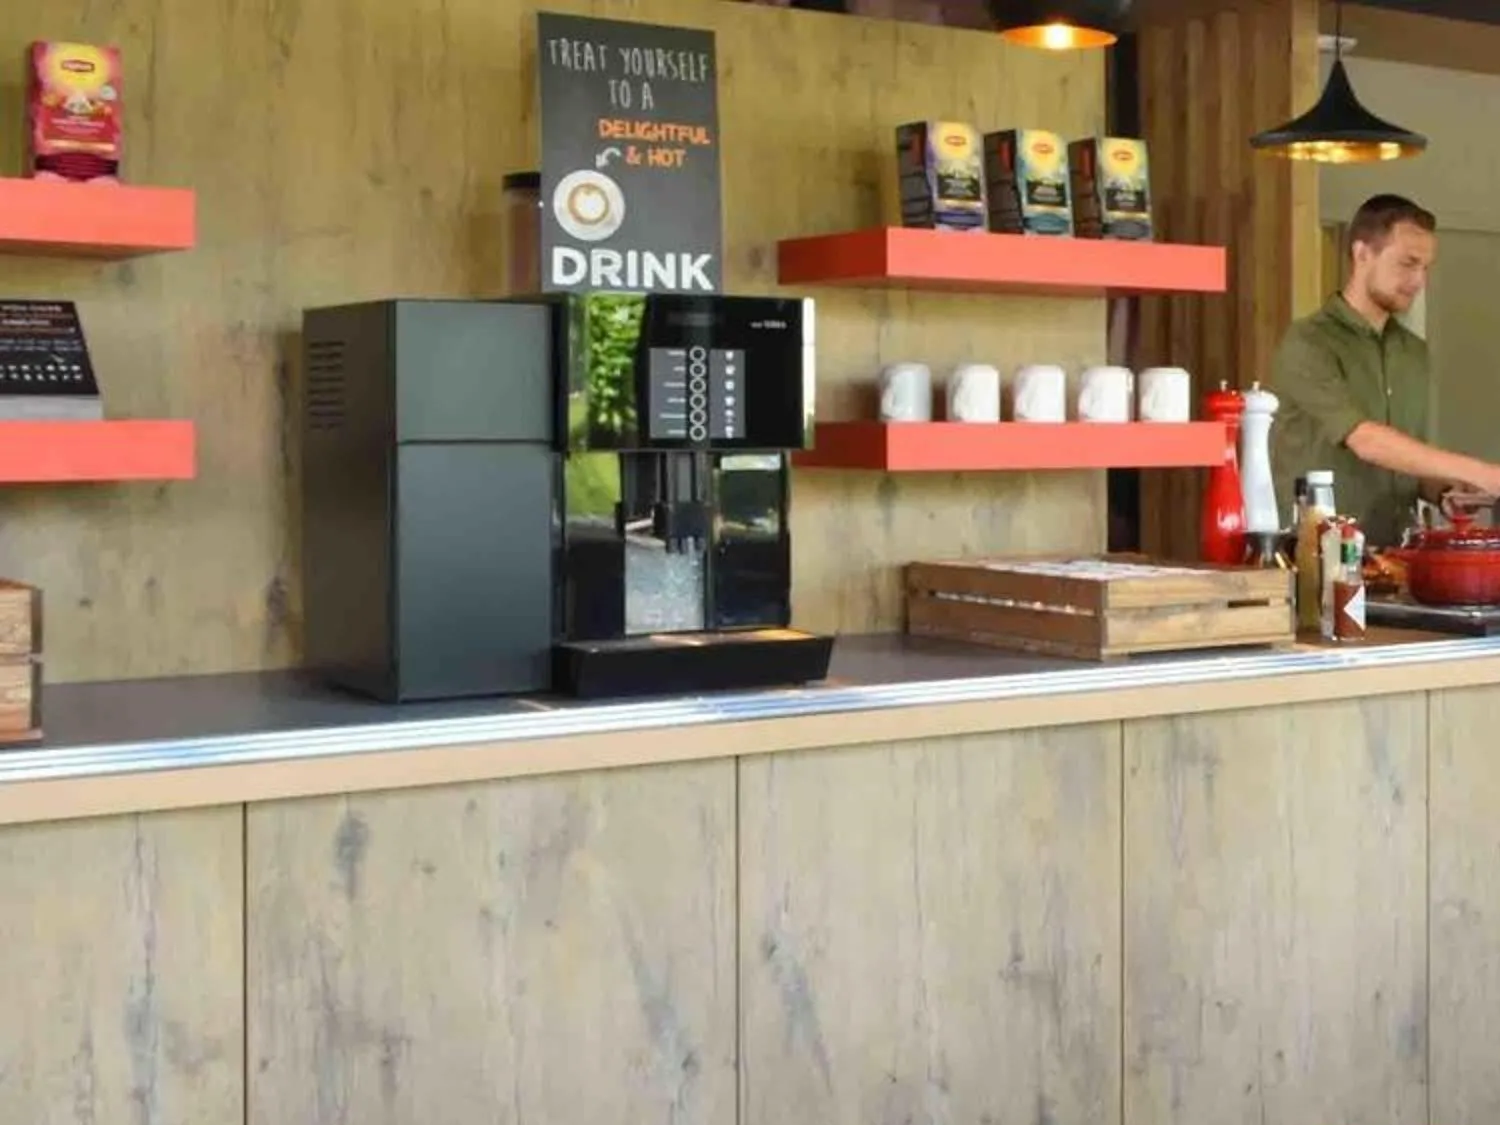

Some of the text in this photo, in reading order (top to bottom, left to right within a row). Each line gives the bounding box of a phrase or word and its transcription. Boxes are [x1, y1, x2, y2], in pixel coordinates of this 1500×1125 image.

[549, 38, 709, 82] TREAT YOURSELF
[608, 79, 654, 110] TO A
[598, 118, 711, 145] DELIGHTFUL
[626, 146, 687, 168] & HOT
[552, 246, 714, 291] DRINK
